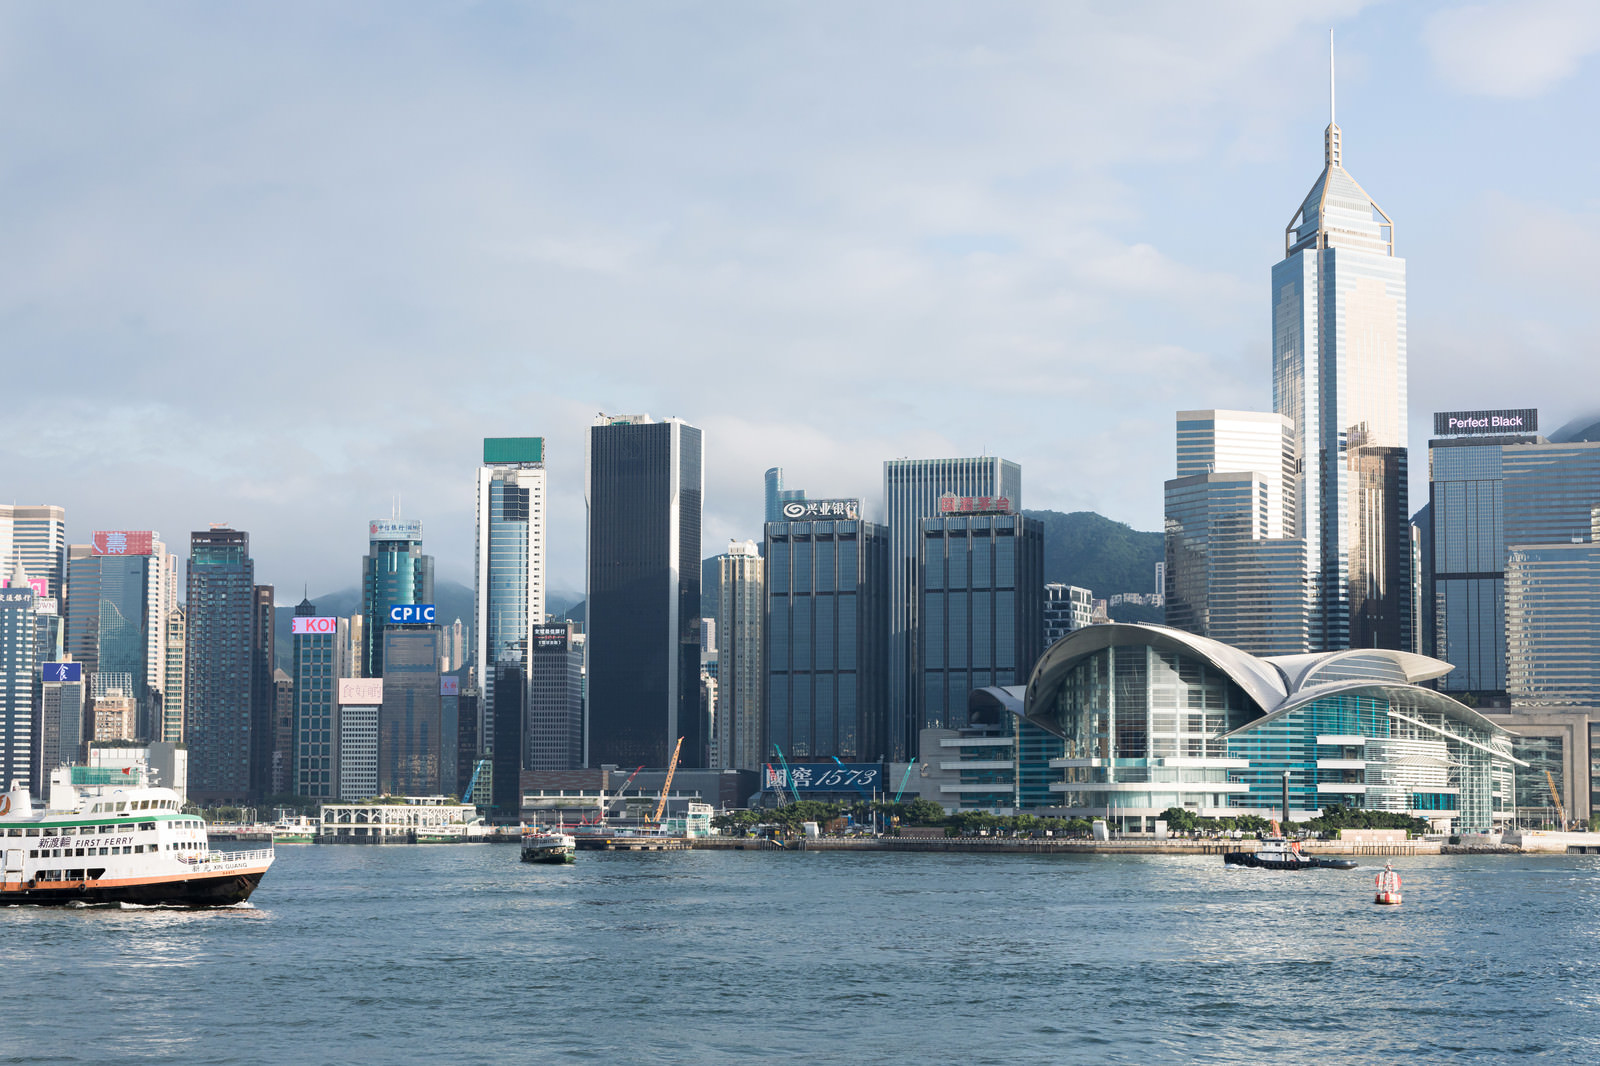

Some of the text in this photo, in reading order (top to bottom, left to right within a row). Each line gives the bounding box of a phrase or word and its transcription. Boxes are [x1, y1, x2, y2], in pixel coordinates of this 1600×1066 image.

[1448, 415, 1523, 428] Perfect Black
[805, 501, 858, 519] 兴业银行
[391, 607, 434, 621] CPIC
[815, 769, 878, 786] 1573
[38, 836, 134, 848] 新渡輪 FIRST FERRY
[225, 862, 248, 870] GUANG
